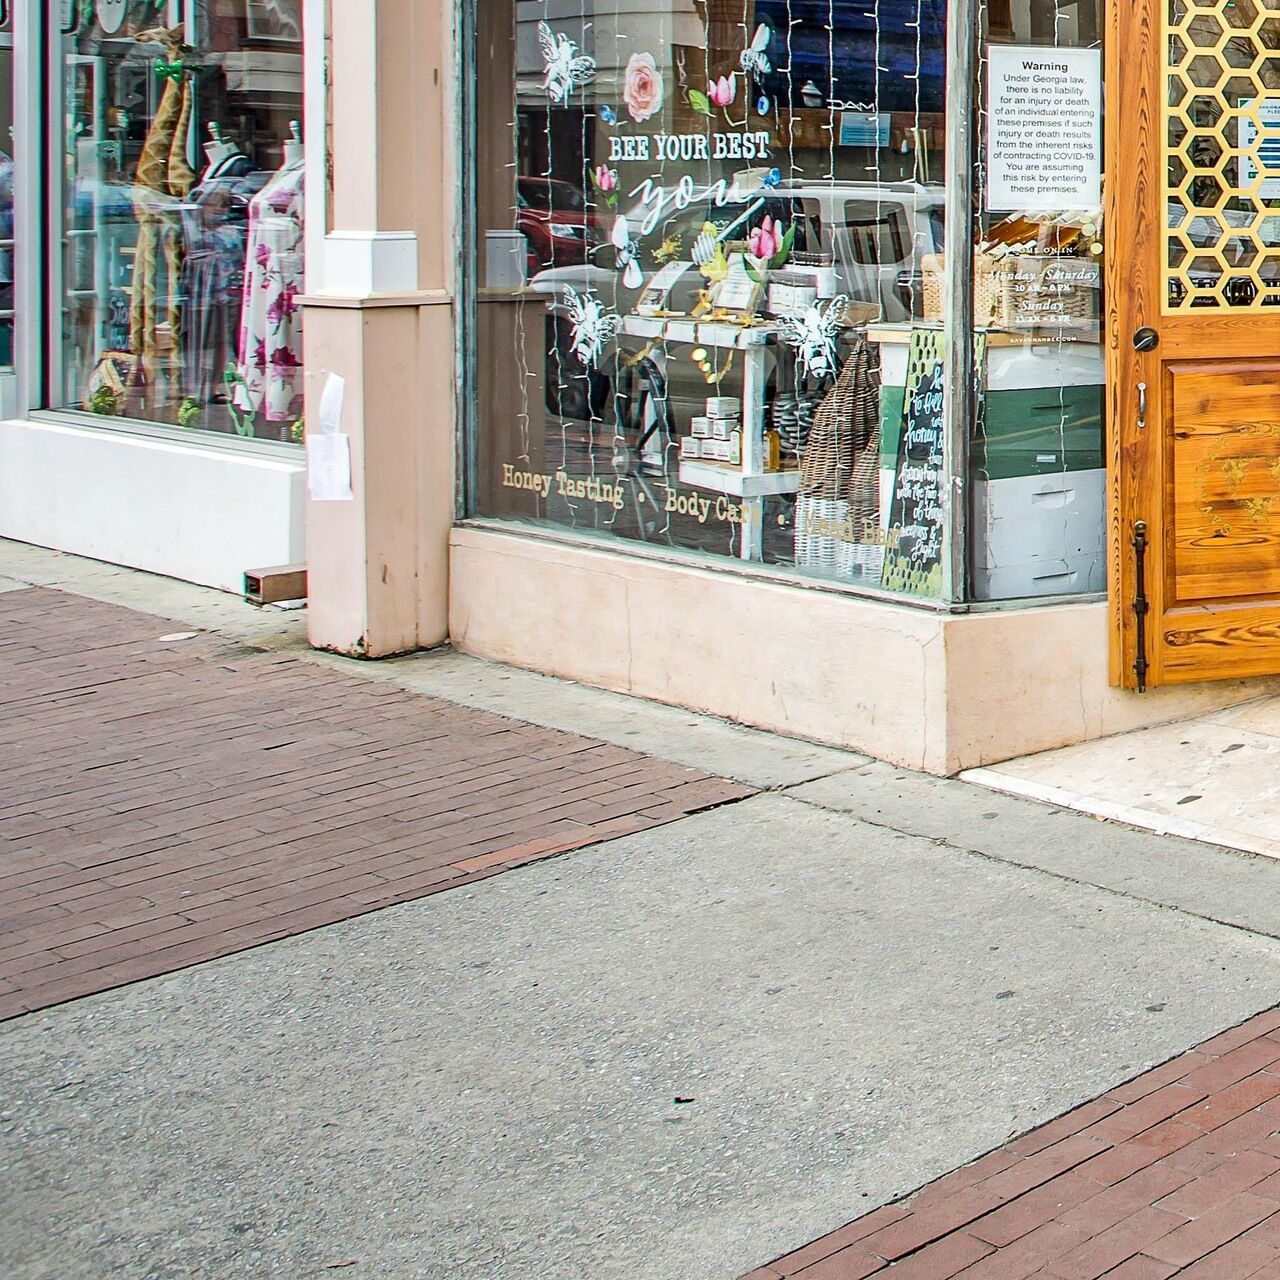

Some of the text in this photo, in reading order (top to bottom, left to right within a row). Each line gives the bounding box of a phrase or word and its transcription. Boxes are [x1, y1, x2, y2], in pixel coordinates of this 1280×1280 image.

[1022, 61, 1069, 73] Warning
[1003, 74, 1030, 82] Under
[1033, 74, 1067, 85] Georgia
[1006, 85, 1029, 94] there
[1031, 86, 1039, 94] is
[1055, 86, 1084, 96] liability
[1000, 96, 1012, 104] for
[1028, 97, 1052, 107] injury
[1065, 97, 1090, 106] death
[995, 107, 1004, 115] of
[1017, 107, 1059, 116] individual
[1060, 109, 1095, 118] entering
[997, 119, 1093, 128] these premises if such
[998, 130, 1022, 139] injury
[1035, 130, 1061, 138] death
[1063, 131, 1092, 139] results
[608, 131, 770, 161] BEE YOUR BEST
[996, 140, 1017, 148] from
[1035, 141, 1071, 149] inherent
[1073, 141, 1094, 150] risks
[993, 151, 1096, 161] of contracting COVID-19.
[1006, 162, 1023, 171] You
[1042, 163, 1084, 173] assuming
[1003, 174, 1087, 184] this risk by entering
[1010, 185, 1035, 193] these
[628, 174, 755, 236] you
[1045, 268, 1098, 281] Saturday
[1020, 299, 1064, 312] Sunday
[908, 419, 937, 453] honey
[502, 462, 553, 496] Honey
[556, 470, 626, 511] Tasting
[665, 487, 714, 524] Body
